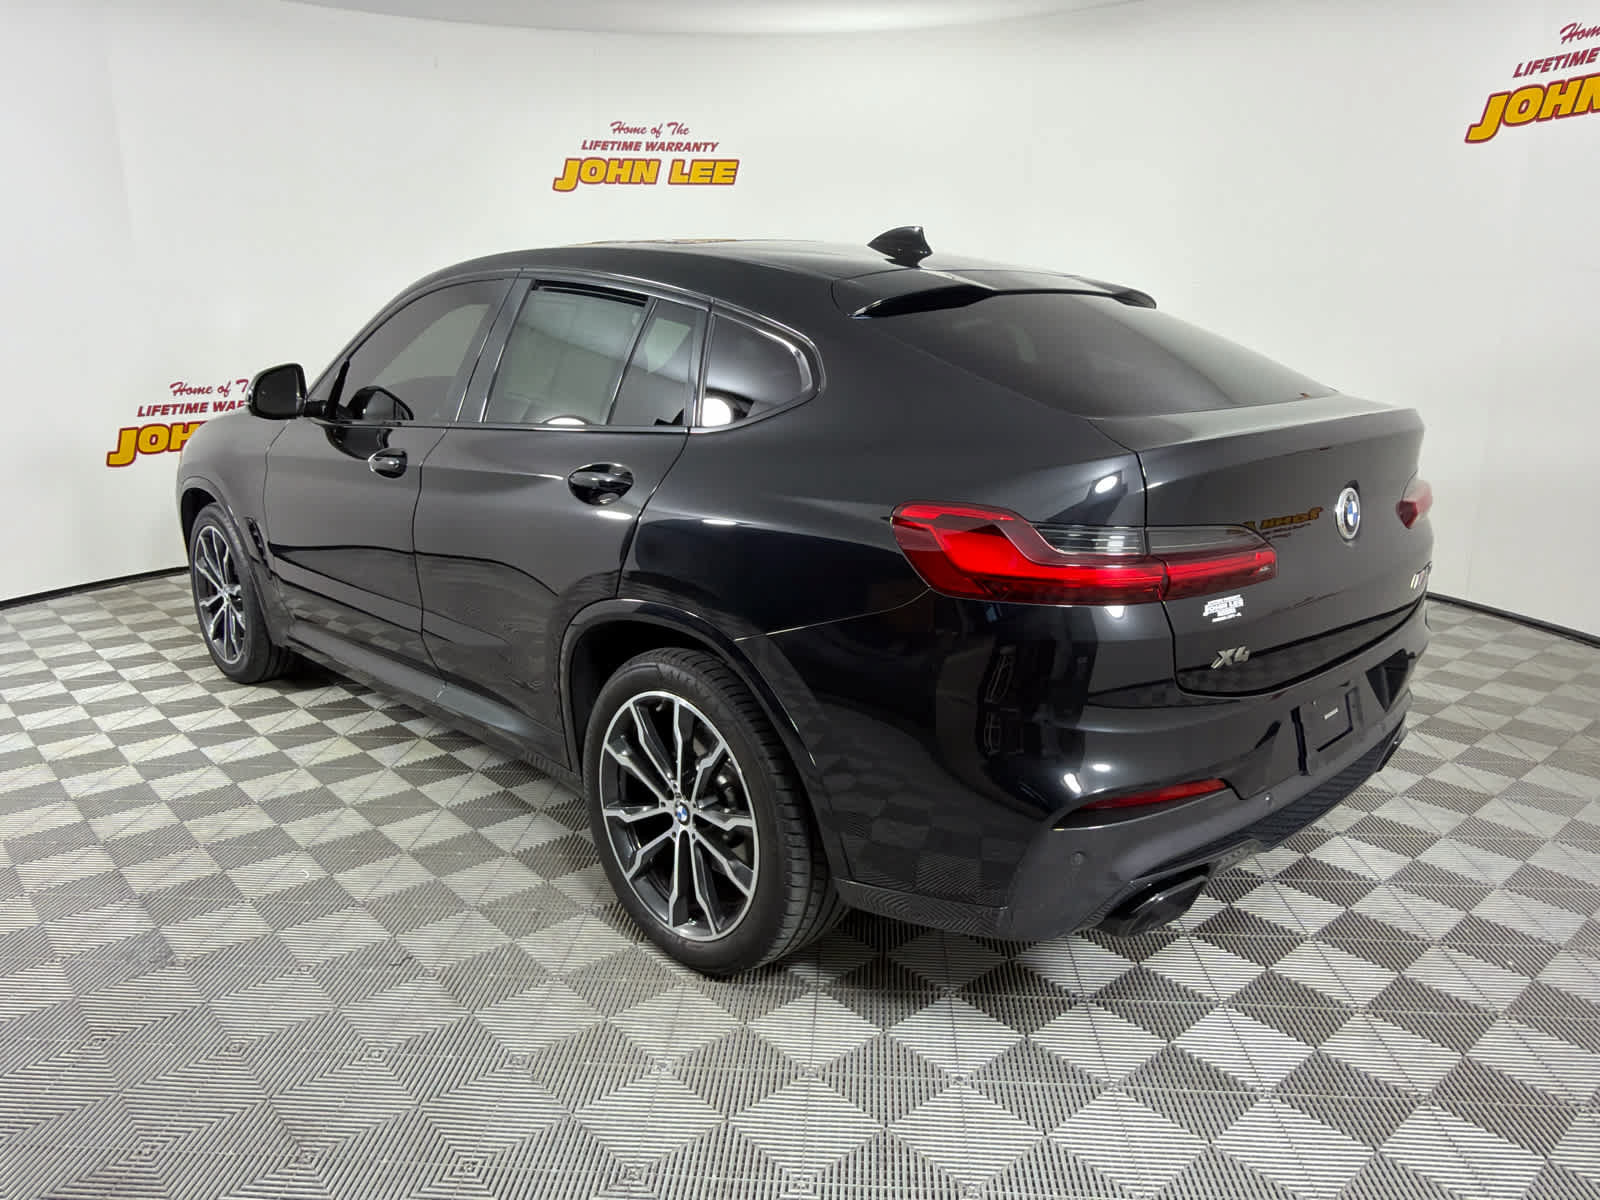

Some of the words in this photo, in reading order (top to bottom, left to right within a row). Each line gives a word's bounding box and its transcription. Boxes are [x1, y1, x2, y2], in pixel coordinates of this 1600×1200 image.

[1512, 46, 1600, 78] LIFETIME
[1464, 72, 1600, 144] JOHN
[610, 121, 647, 134] Home
[650, 123, 663, 138] of
[667, 122, 690, 135] The
[581, 140, 642, 151] LIFETIME
[645, 142, 719, 152] WARRANTY
[552, 157, 661, 192] JOHN
[668, 159, 739, 185] LEE
[170, 381, 212, 396] Home
[217, 380, 231, 397] of
[137, 401, 208, 417] LIFETIME
[1211, 645, 1250, 669] X4
